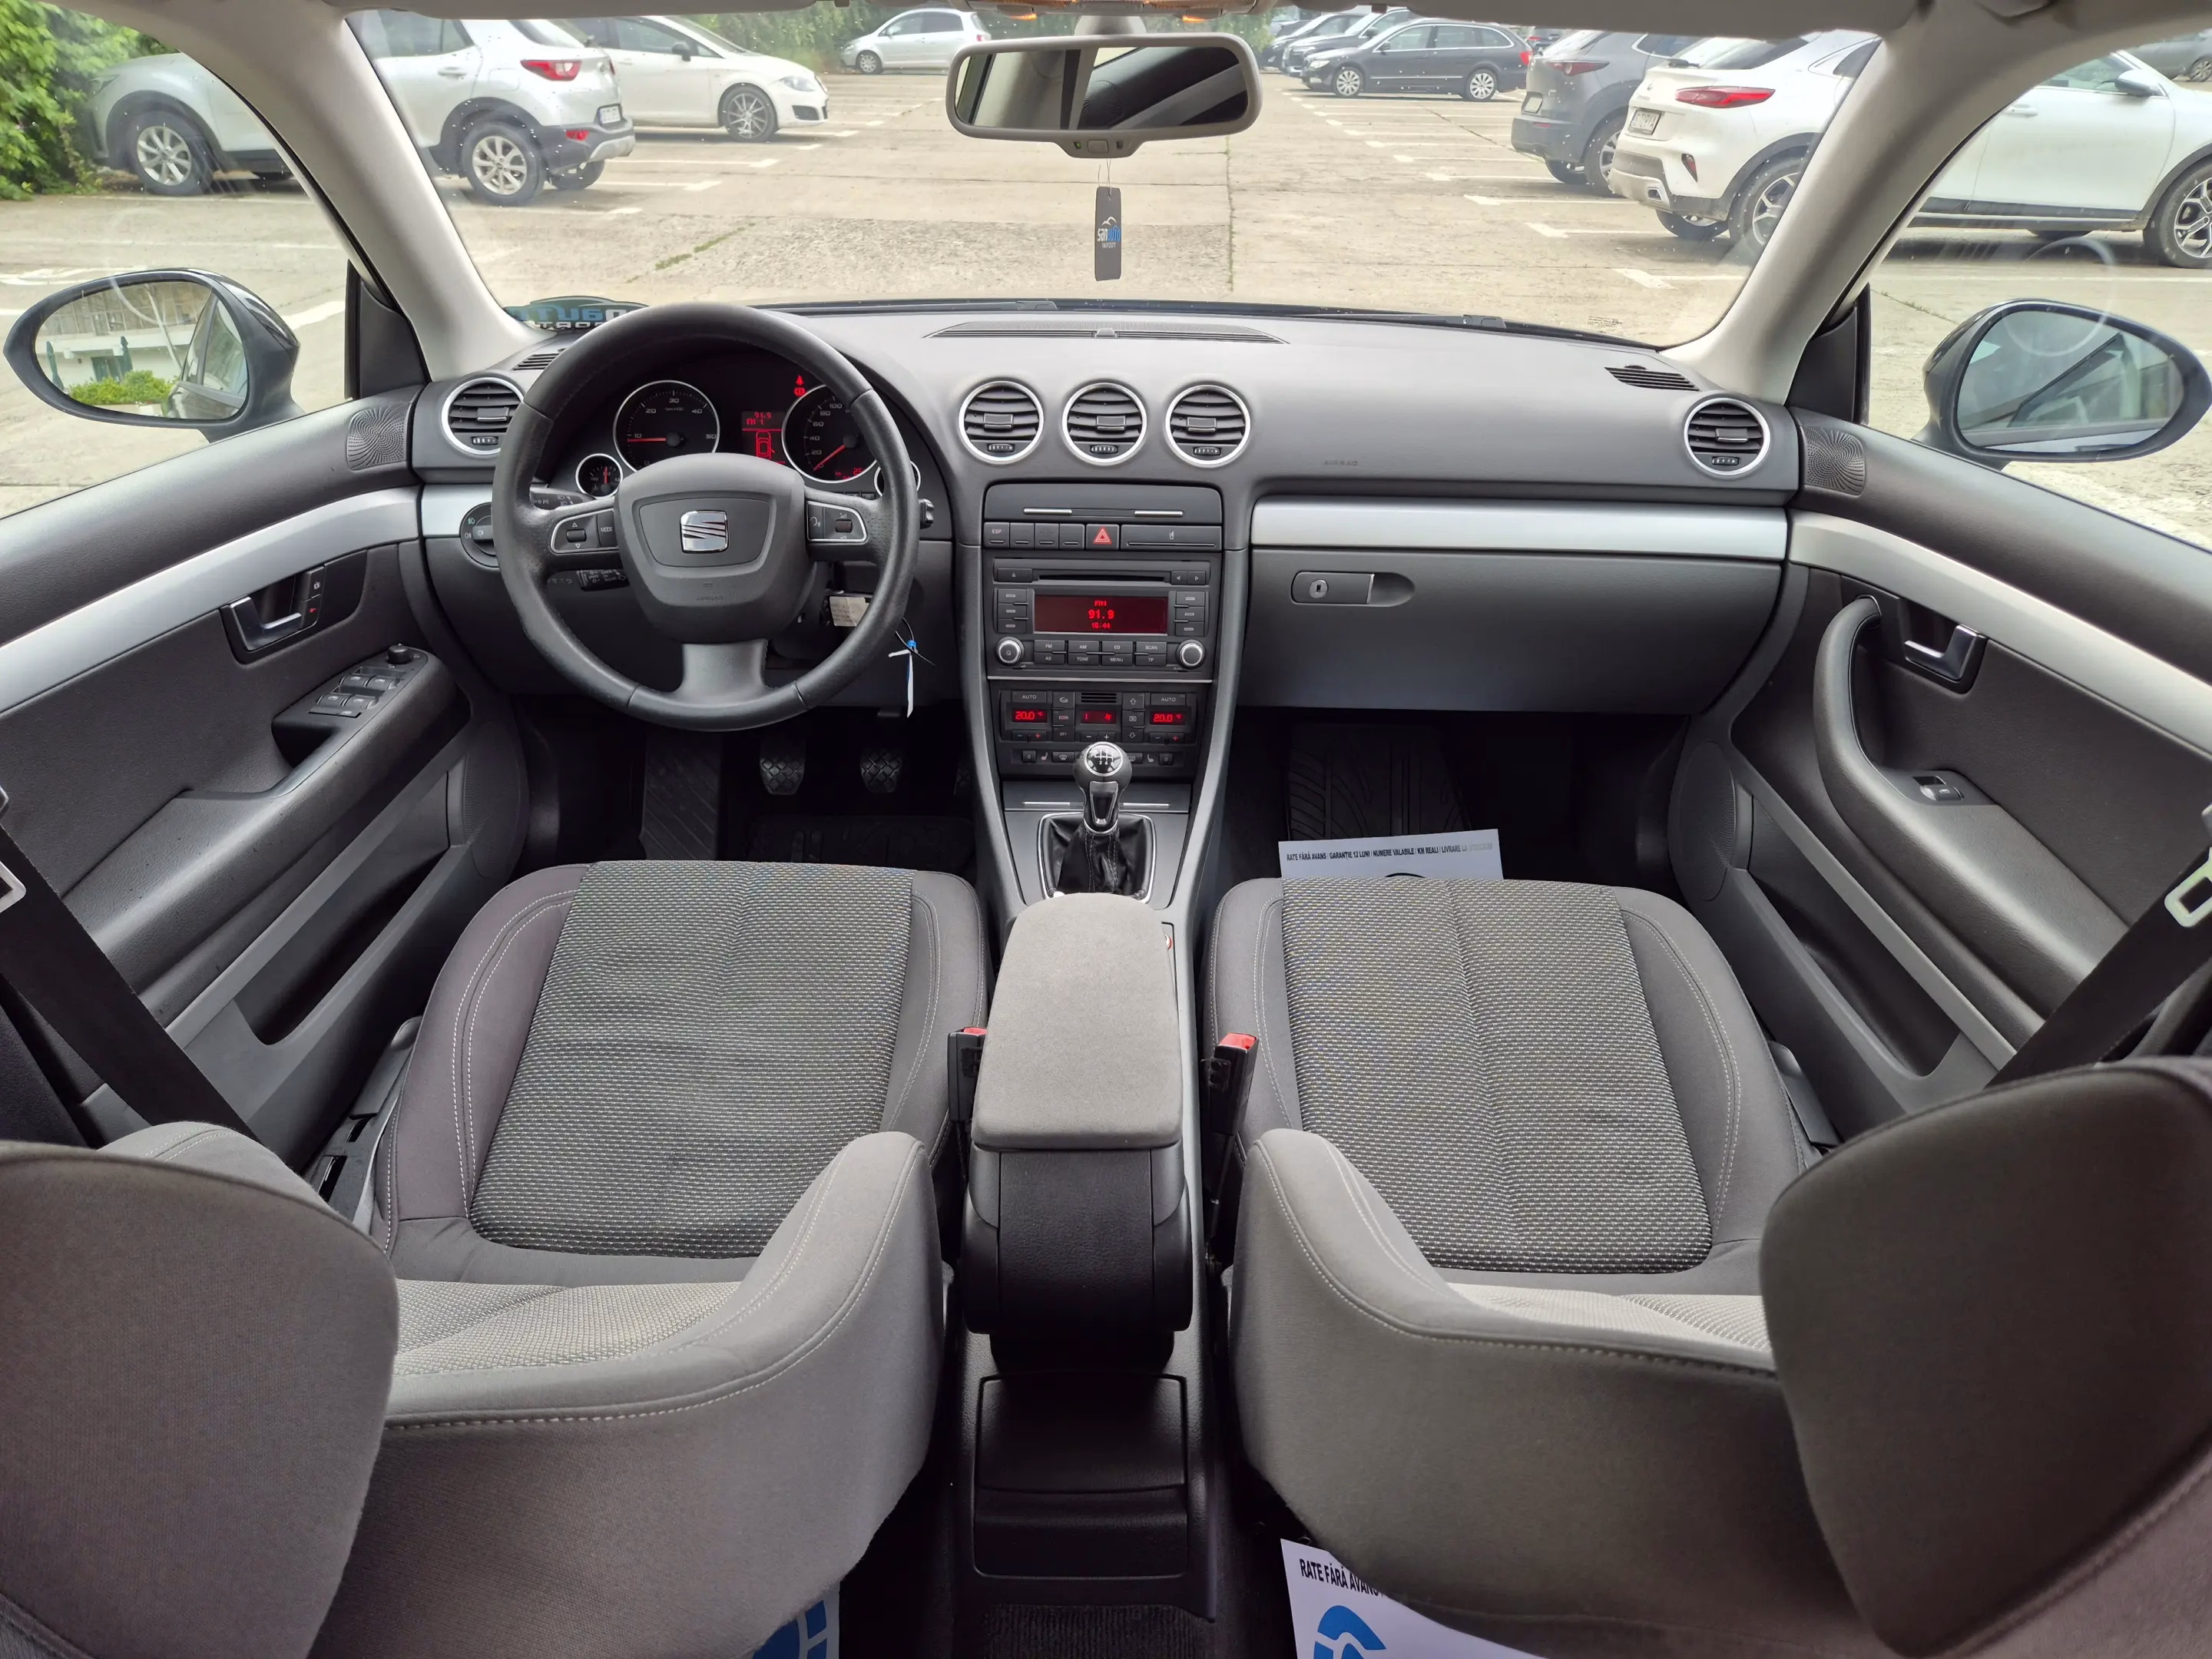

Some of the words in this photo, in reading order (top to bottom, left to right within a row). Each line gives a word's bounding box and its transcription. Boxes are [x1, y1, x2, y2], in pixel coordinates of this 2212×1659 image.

[1088, 609, 1114, 620] 91.9
[1015, 710, 1035, 720] 20.0
[1154, 714, 1174, 723] 20.0
[1392, 847, 1415, 856] VALABILE
[1300, 1558, 1324, 1581] RATE
[1324, 1562, 1349, 1588] FĂRĂ
